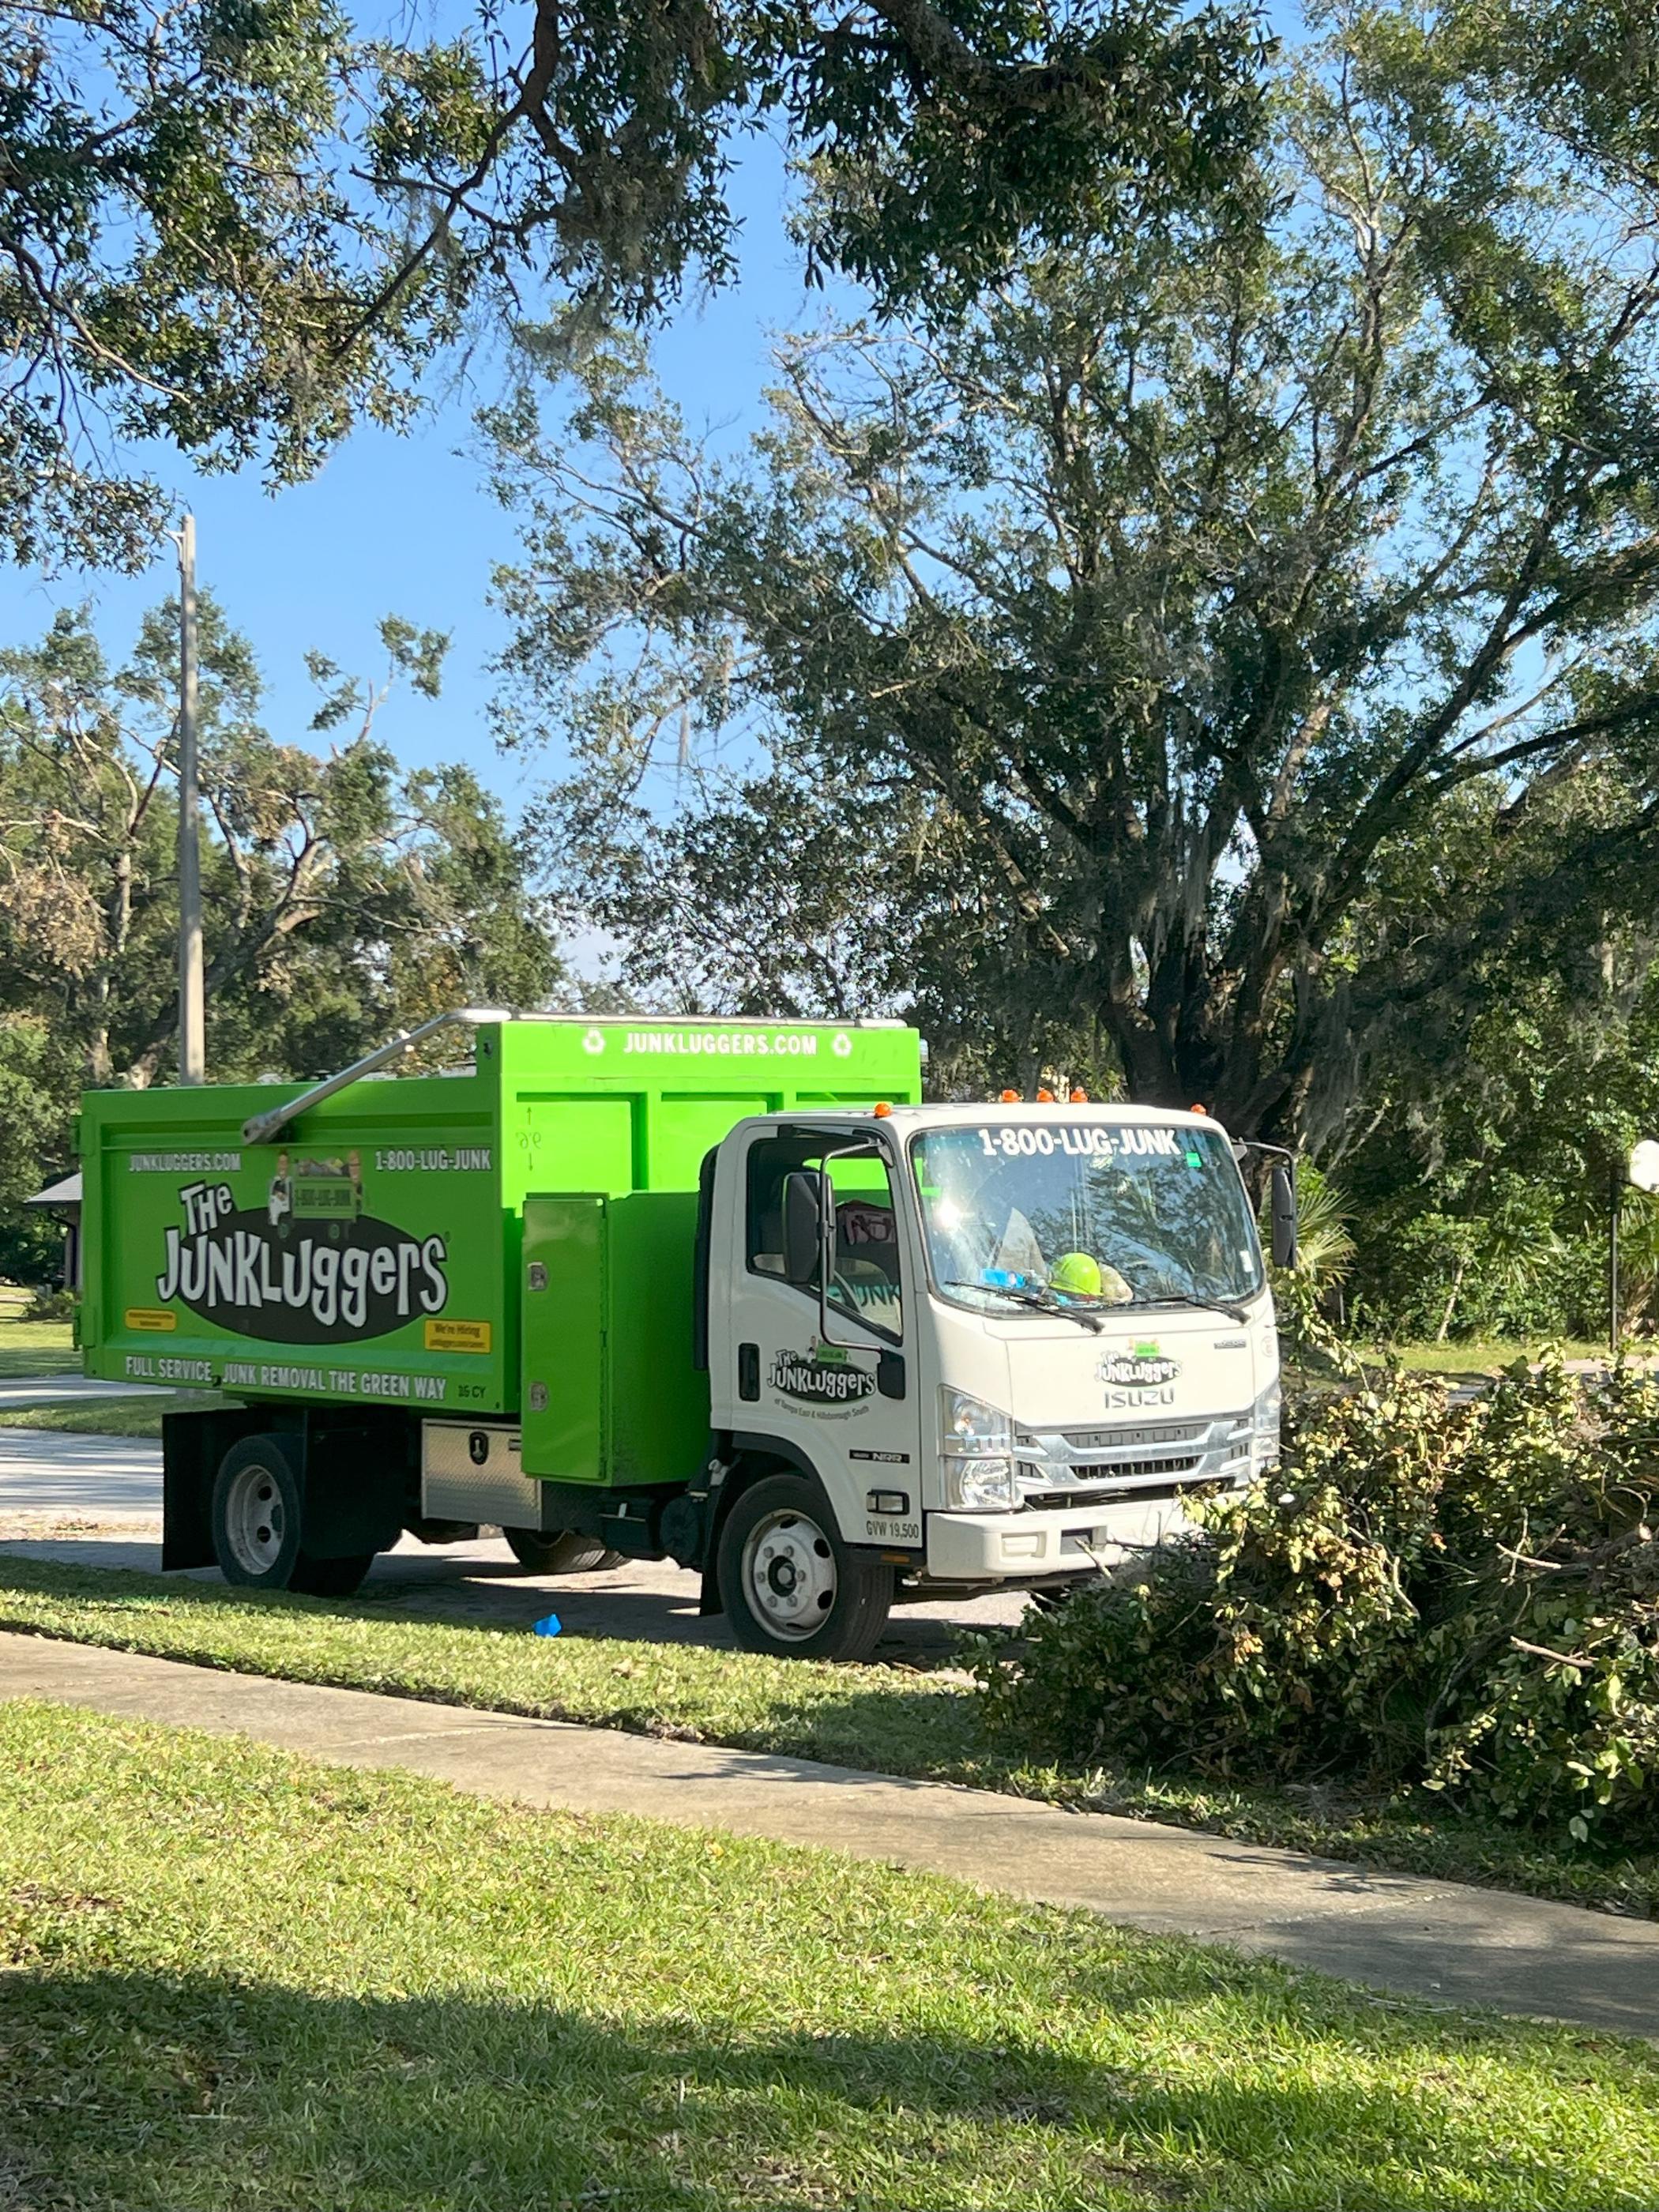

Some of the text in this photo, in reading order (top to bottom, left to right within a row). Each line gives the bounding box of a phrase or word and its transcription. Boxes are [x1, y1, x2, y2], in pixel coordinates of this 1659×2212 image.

[623, 1033, 818, 1055] JUNKLUGGERS.COM
[978, 1128, 1181, 1156] 1-800-LUG-JUNK
[129, 1153, 241, 1172] JUNKLUGGERS.COM
[374, 1149, 491, 1171] 1-800-LUG-JUNK
[126, 1356, 446, 1400] FULL SERVICE JUNK REMOVAL THE GREEN WAY
[1104, 1387, 1174, 1409] ISUZU
[866, 1521, 919, 1539] GVW 19,500
